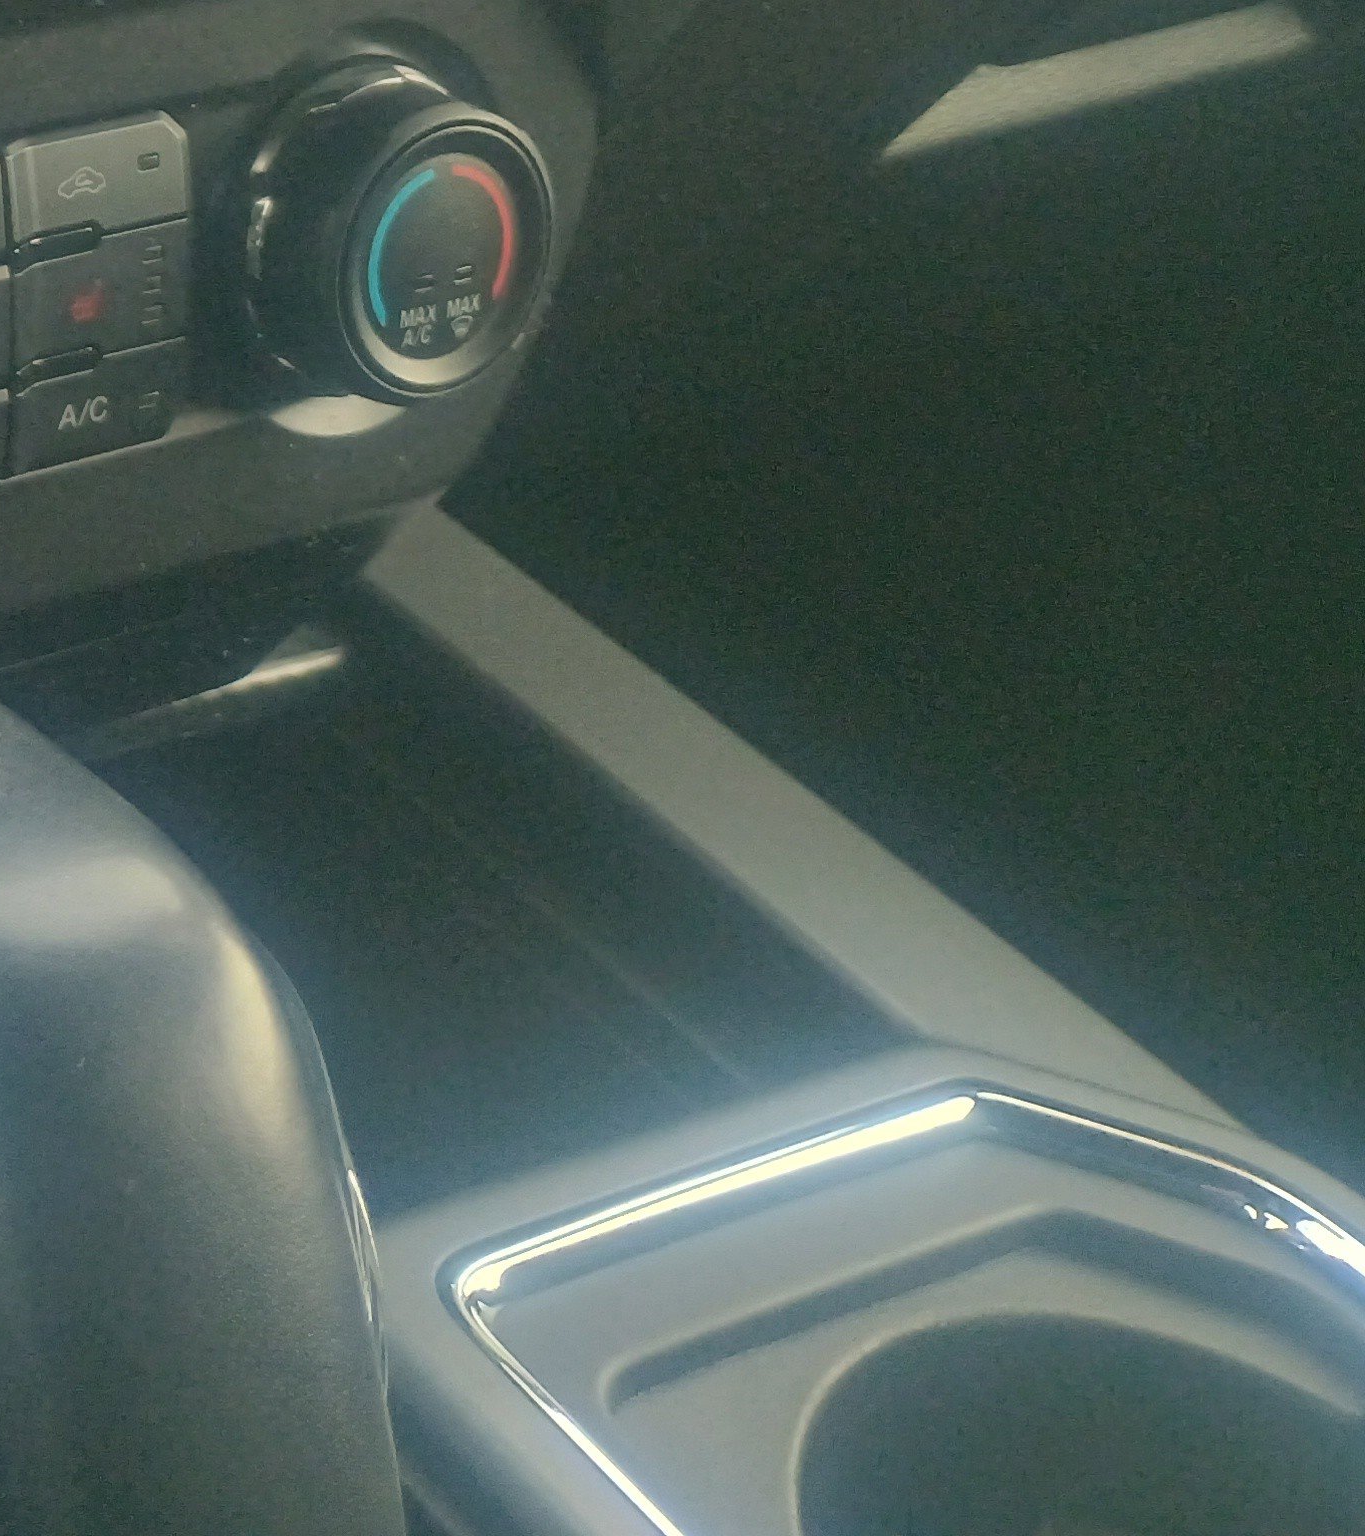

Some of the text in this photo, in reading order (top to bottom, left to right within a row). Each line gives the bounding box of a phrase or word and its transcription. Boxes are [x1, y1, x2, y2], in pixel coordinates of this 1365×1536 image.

[400, 304, 437, 329] MAX
[447, 293, 481, 318] MAX
[57, 394, 108, 431] A/C
